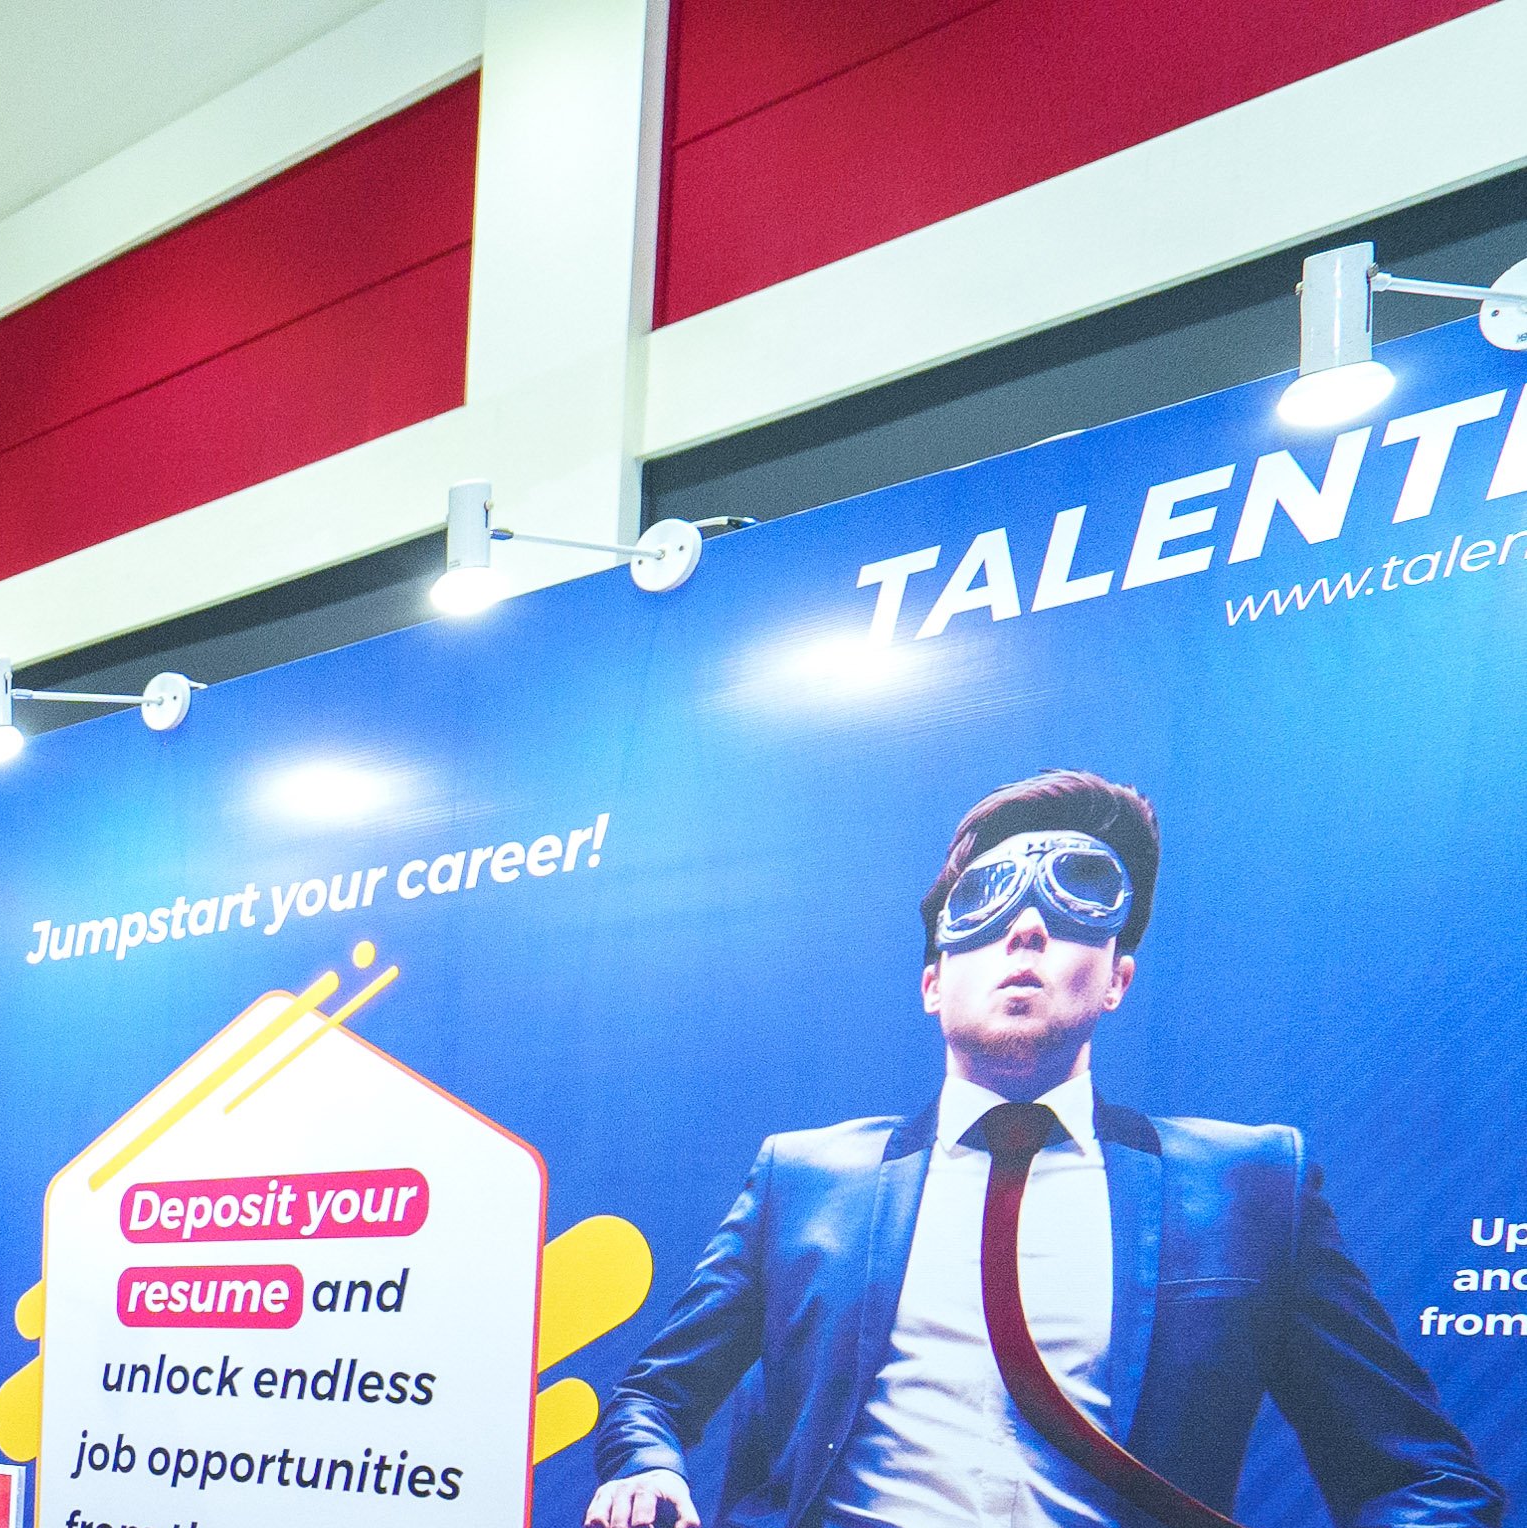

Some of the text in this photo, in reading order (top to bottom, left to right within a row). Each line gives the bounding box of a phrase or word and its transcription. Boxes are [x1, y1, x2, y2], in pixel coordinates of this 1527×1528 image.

[854, 386, 1527, 648] TALENT
[25, 812, 611, 965] Jumpstart your career!
[129, 1178, 418, 1240] Deposit your
[126, 1267, 410, 1314] resume and
[101, 1354, 437, 1405] unlock endless
[70, 1429, 464, 1501] job opportunities
